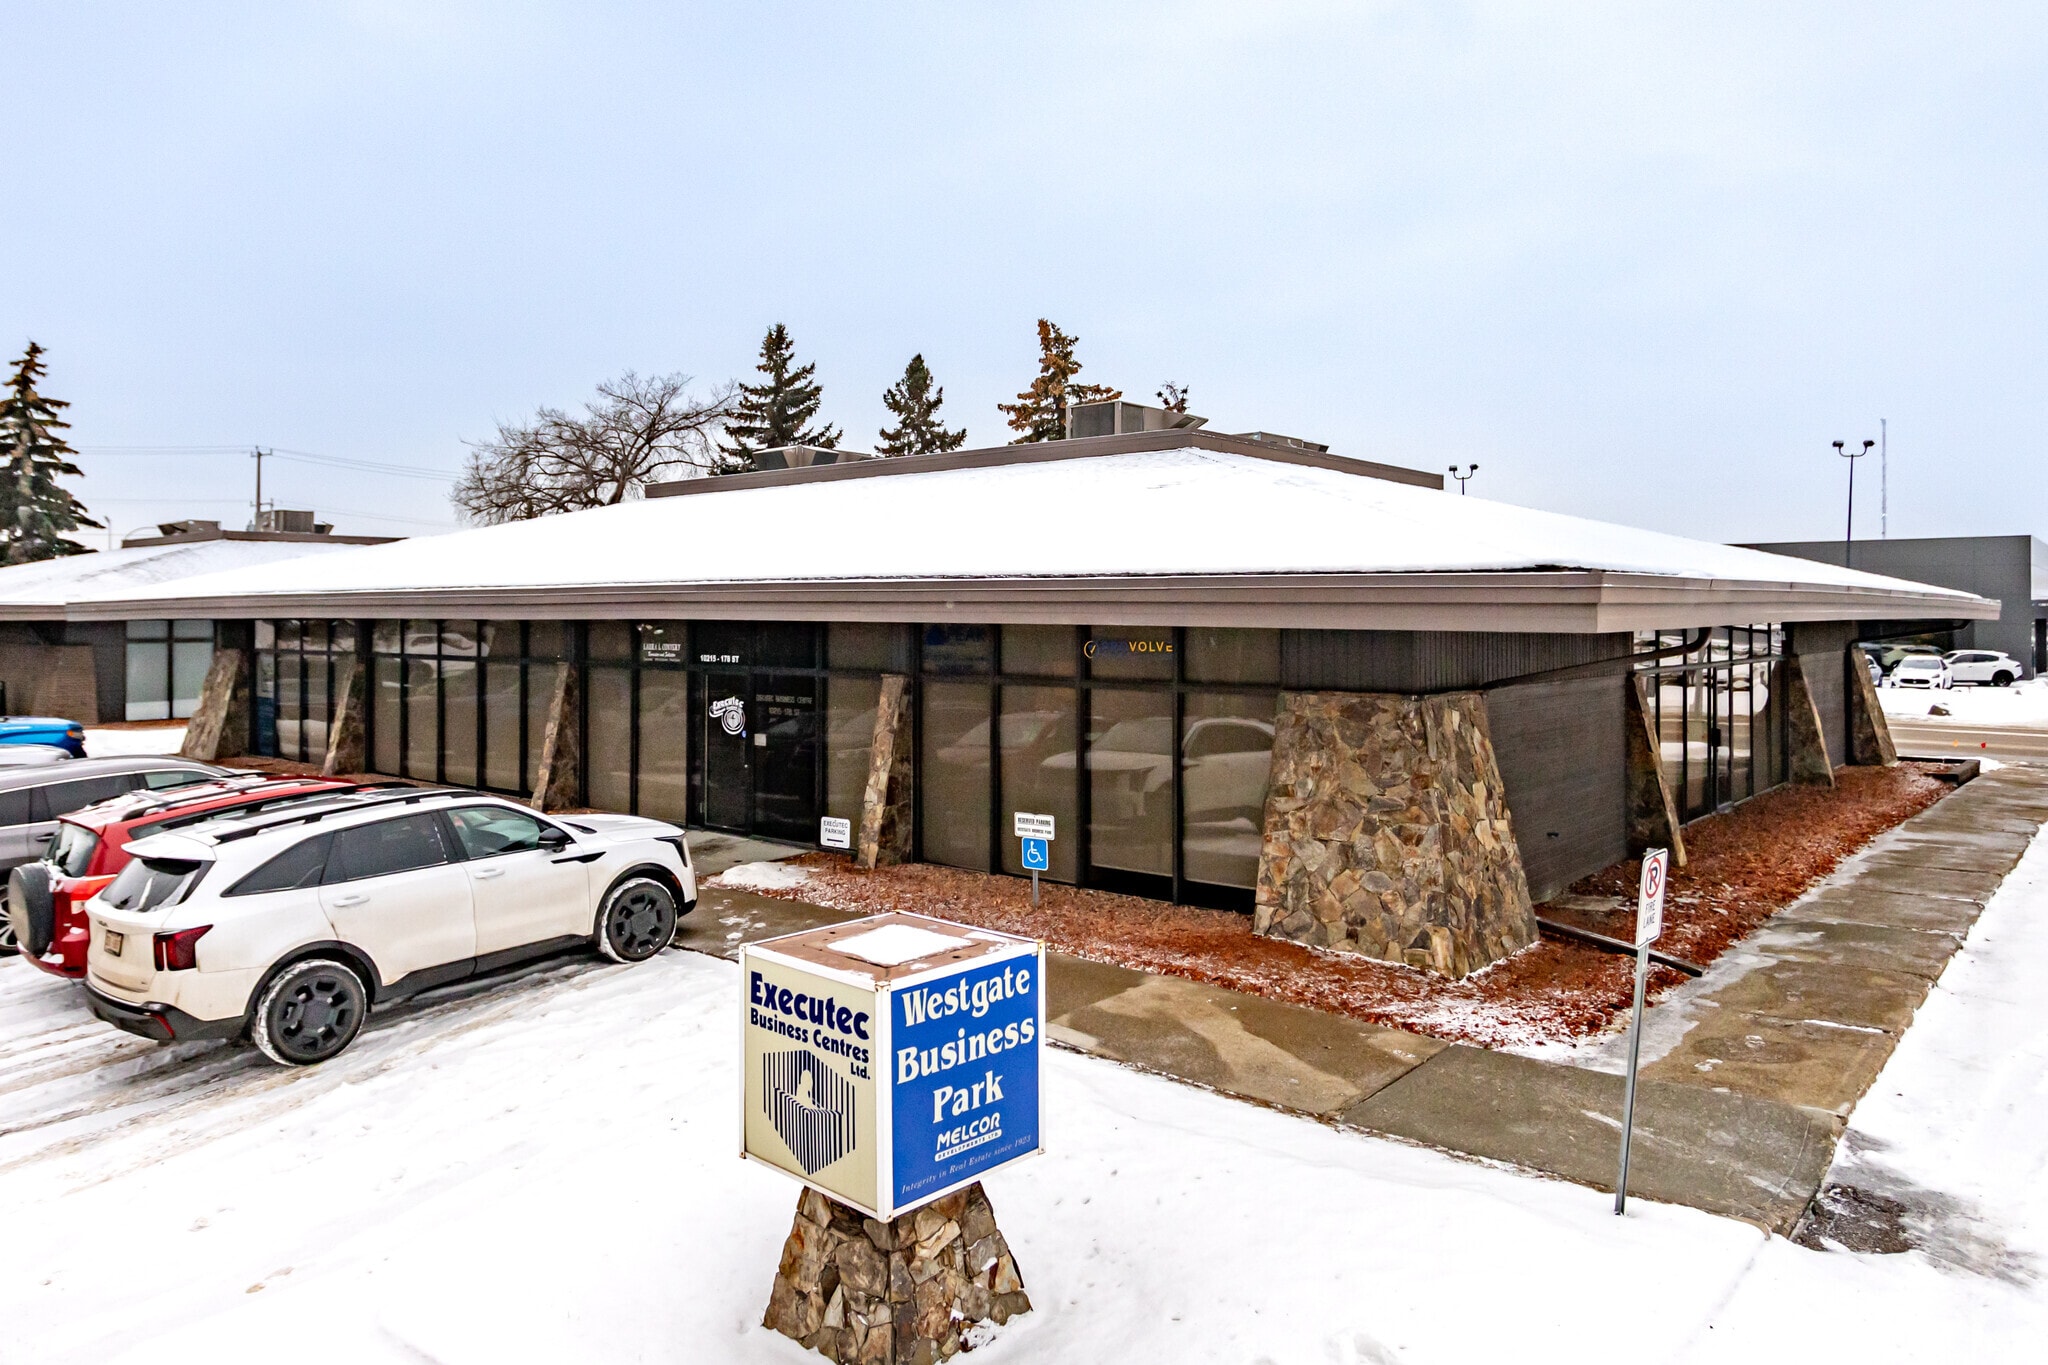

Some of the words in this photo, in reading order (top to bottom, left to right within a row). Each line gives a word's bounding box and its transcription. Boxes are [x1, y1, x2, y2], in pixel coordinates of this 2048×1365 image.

[700, 654, 717, 662] 10215
[731, 655, 740, 663] ST
[823, 820, 848, 829] EXECUTEC
[825, 827, 846, 836] PARKING
[1035, 819, 1051, 827] PARKING
[1645, 900, 1656, 916] FIRE
[1643, 913, 1656, 928] LANE
[750, 970, 870, 1041] Executec
[901, 965, 1031, 1028] Westgate
[750, 1006, 809, 1043] Business
[813, 1028, 869, 1064] Centres
[896, 1017, 1035, 1085] Business
[850, 1061, 871, 1080] Ltd.
[932, 1069, 1005, 1124] Park
[936, 1112, 1001, 1151] MELCOR
[937, 1136, 986, 1160] DEVELOPMENTS
[901, 1174, 937, 1195] Integrity
[938, 1171, 947, 1179] in
[949, 1161, 967, 1174] Real
[968, 1151, 992, 1166] Estate
[993, 1144, 1013, 1157] since
